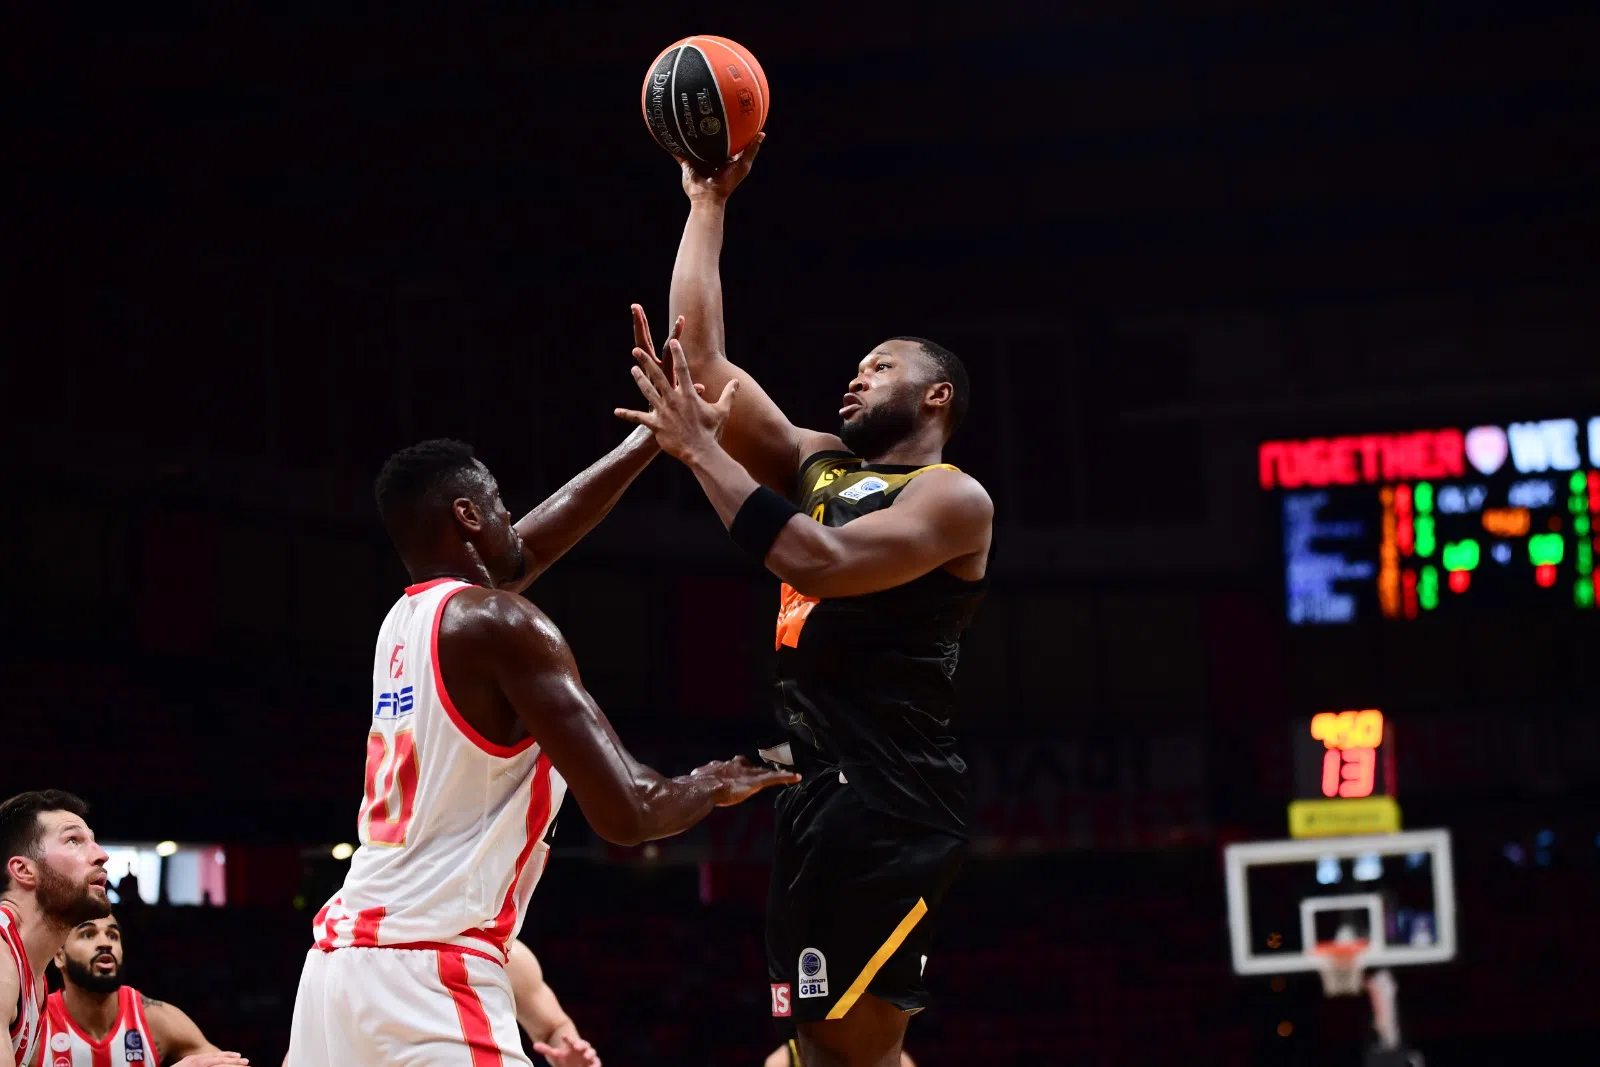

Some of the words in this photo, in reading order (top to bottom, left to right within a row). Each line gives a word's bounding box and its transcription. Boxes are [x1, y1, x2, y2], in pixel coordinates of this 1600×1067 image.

[1258, 427, 1465, 490] TOGETHER
[1507, 418, 1581, 474] WE
[1322, 747, 1376, 799] 13
[801, 984, 826, 995] GBL
